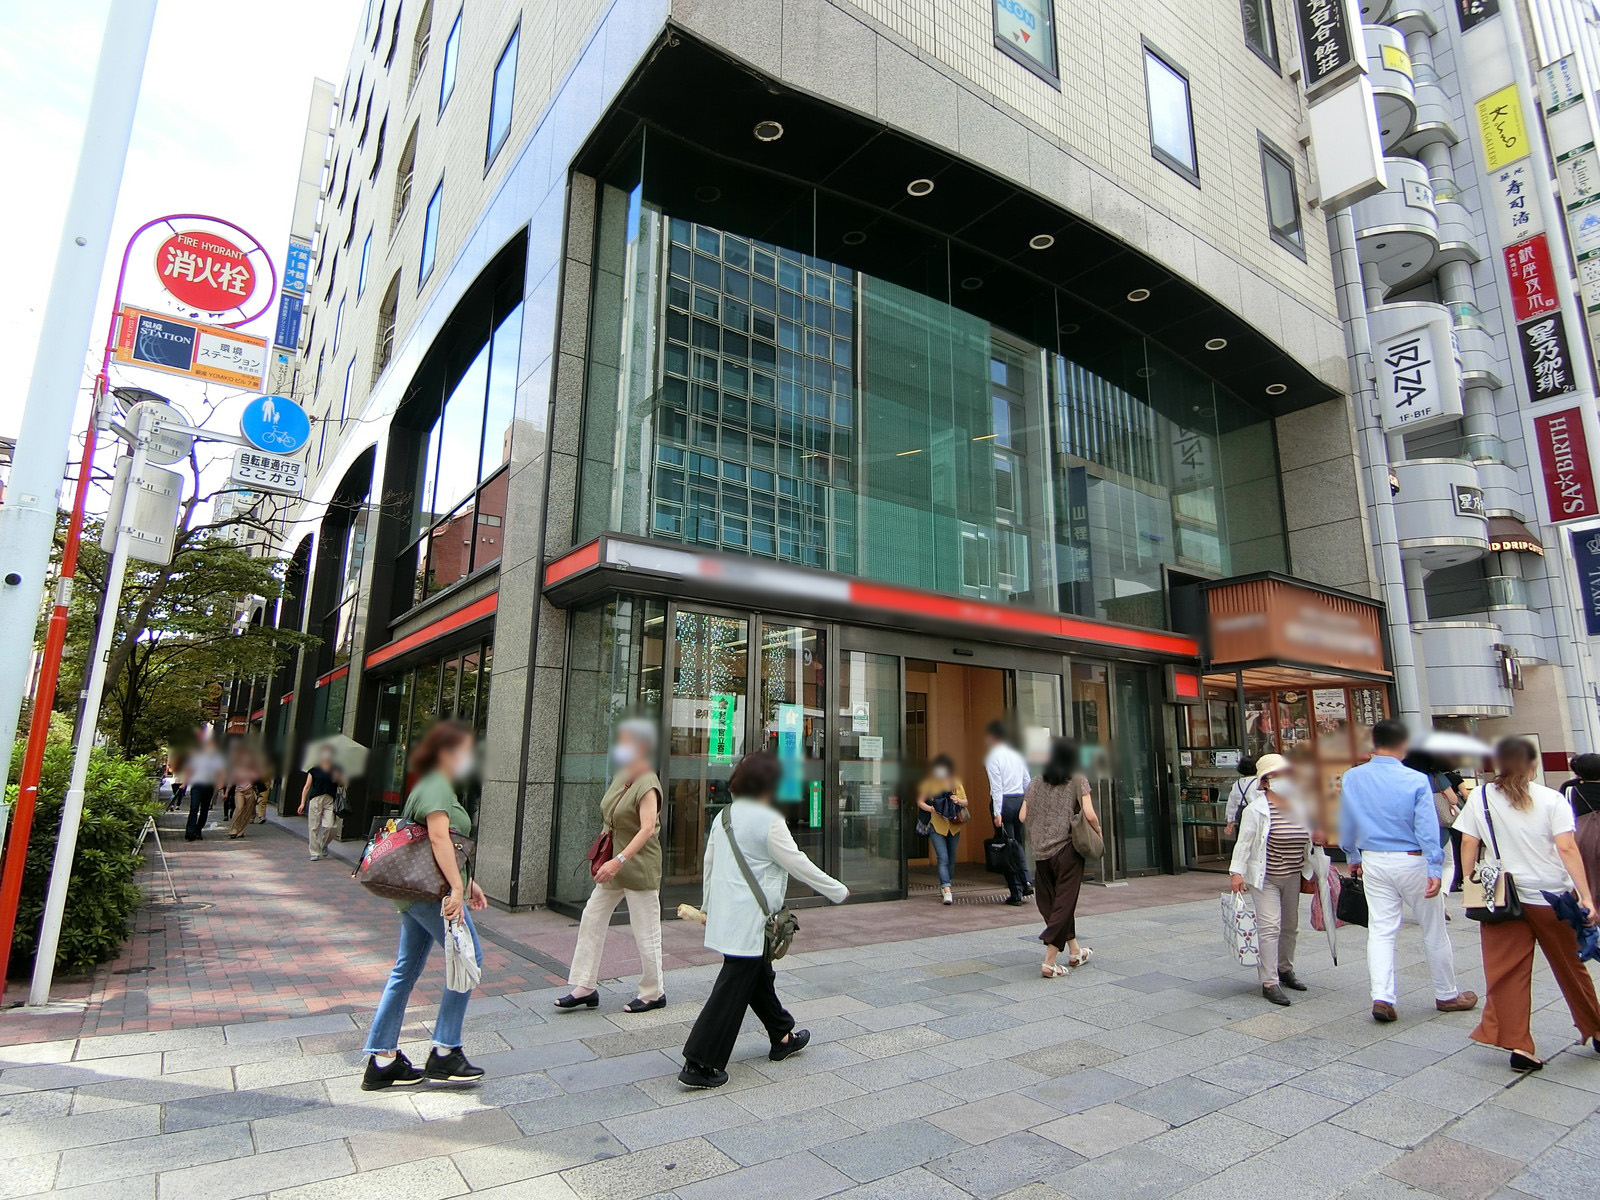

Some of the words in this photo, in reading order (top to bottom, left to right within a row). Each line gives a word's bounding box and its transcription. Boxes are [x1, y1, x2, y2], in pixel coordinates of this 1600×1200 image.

[1479, 103, 1490, 131] BRIDAL
[1484, 132, 1498, 165] GALLERY
[177, 234, 199, 247] FIRE
[201, 241, 244, 260] HYDRANT
[163, 246, 250, 296] 消火栓
[285, 250, 298, 287] イーオン
[139, 328, 192, 345] STATION
[200, 348, 261, 368] ステーション
[219, 343, 243, 356] 環境
[1526, 319, 1565, 393] 星乃珈琲
[240, 453, 300, 474] 自転車通行可
[239, 466, 297, 486] ここから
[1502, 541, 1528, 550] DRIP
